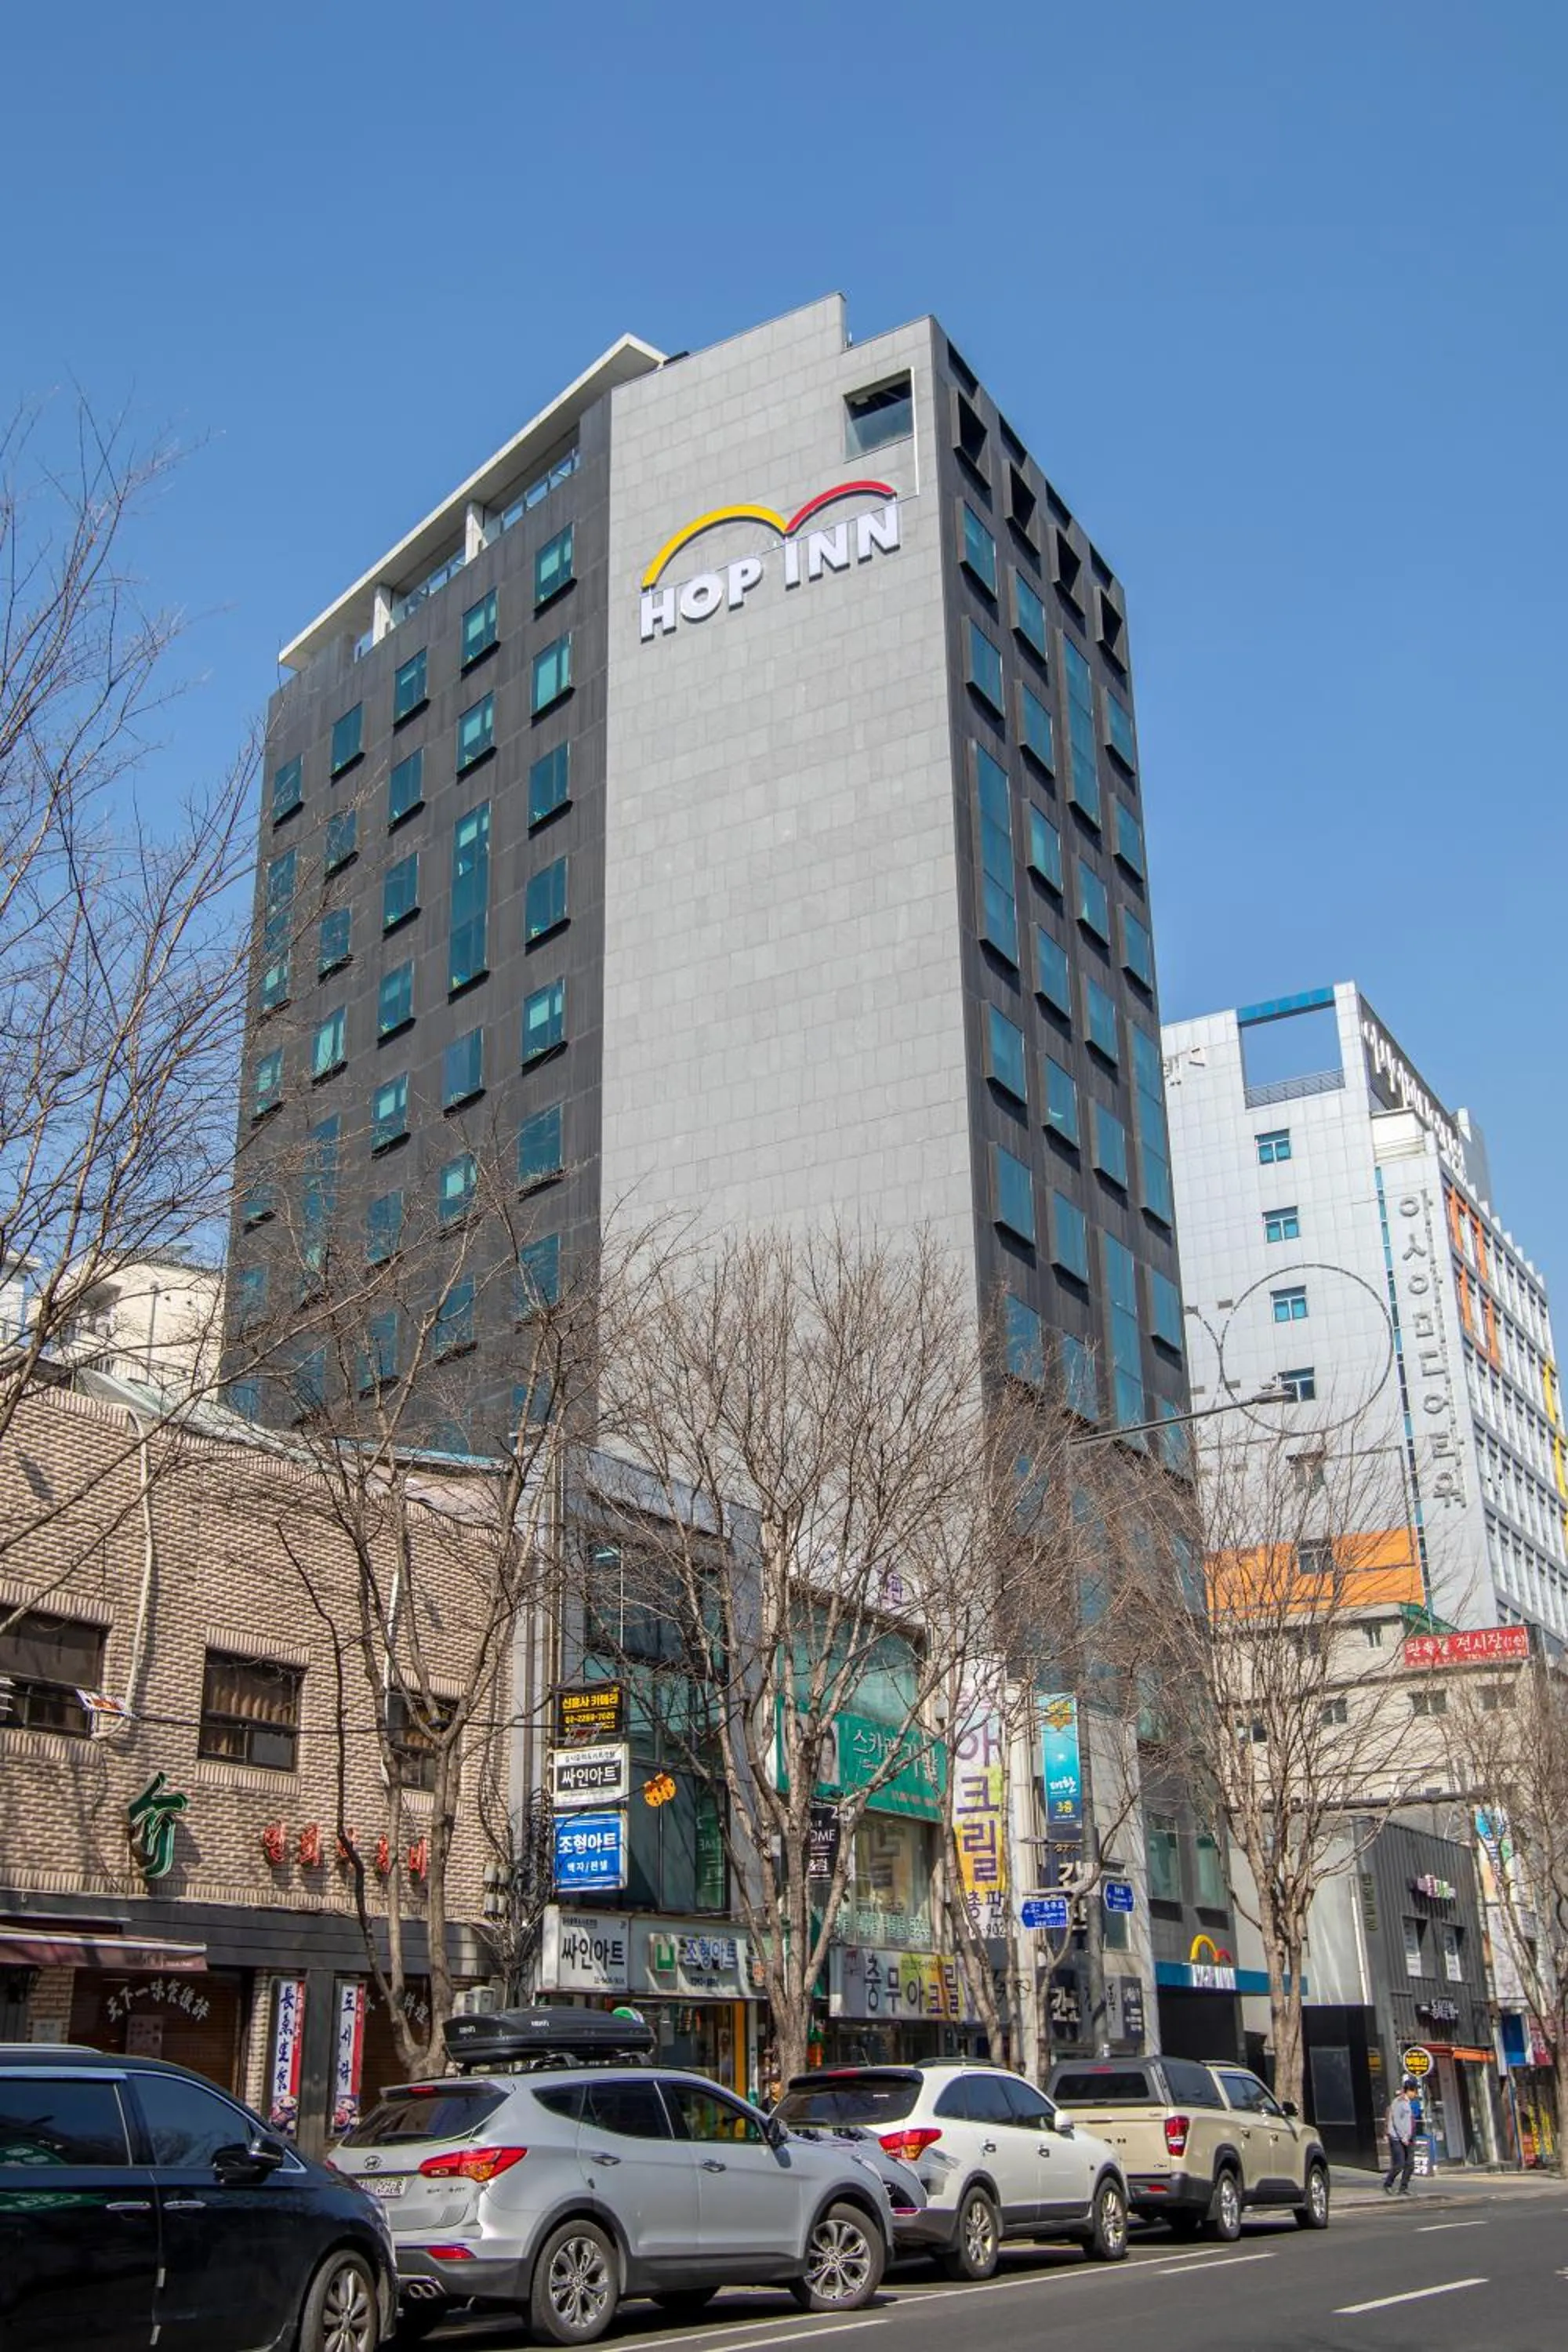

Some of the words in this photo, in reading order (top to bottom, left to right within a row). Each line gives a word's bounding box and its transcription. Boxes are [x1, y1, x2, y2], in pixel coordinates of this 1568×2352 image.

[640, 556, 763, 643] HOP
[785, 502, 900, 591] INN
[561, 1766, 618, 1788] 싸인아트
[954, 1730, 1000, 1883] 아크릴
[558, 1832, 618, 1854] 조형아트
[967, 1890, 1005, 1918] 총판
[561, 1933, 625, 1969] 싸인아트
[684, 1936, 738, 1970] 조형아트
[865, 1953, 960, 2015] 충무아크릴
